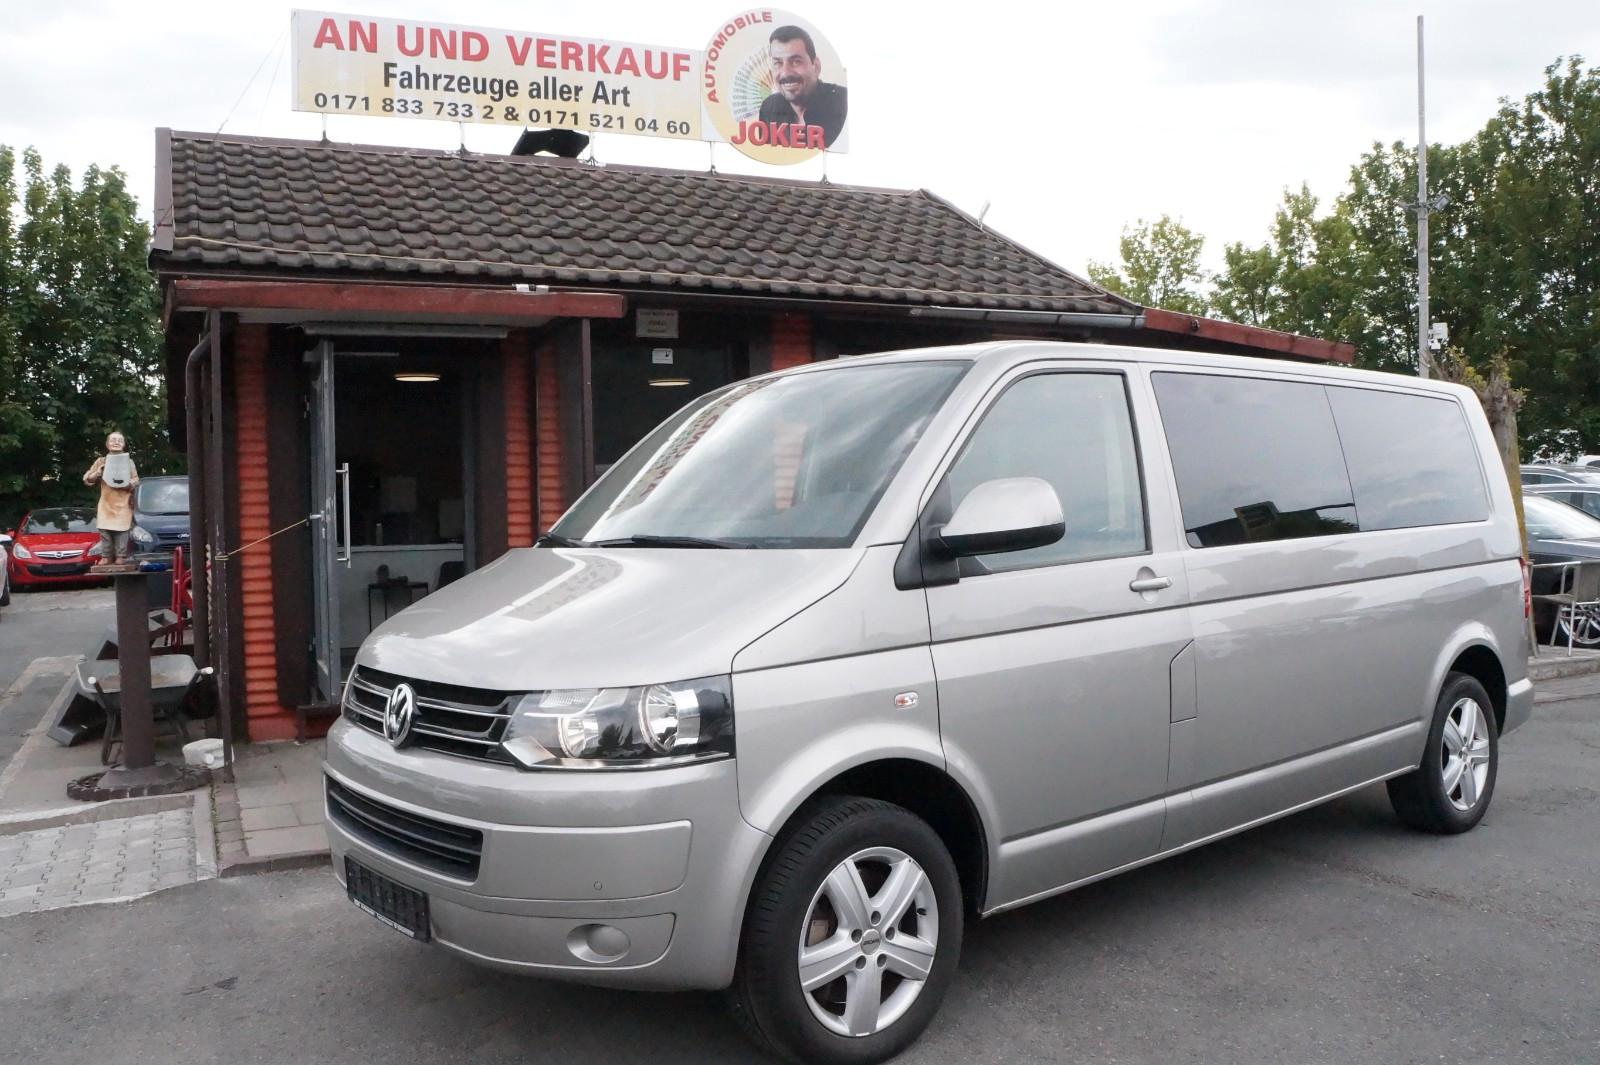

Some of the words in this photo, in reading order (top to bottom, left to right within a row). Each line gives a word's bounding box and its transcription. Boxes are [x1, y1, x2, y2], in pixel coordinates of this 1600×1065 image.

[313, 18, 377, 53] AN
[397, 24, 489, 62] UND
[505, 35, 690, 81] VERKAUF
[705, 11, 772, 103] AUTOMOBILE
[383, 62, 519, 102] Fahrzeuge
[528, 76, 583, 103] aller
[592, 80, 630, 107] Art
[314, 93, 370, 111] 0171
[382, 98, 423, 115] 833
[433, 102, 473, 118] 733
[482, 105, 494, 120] 2
[504, 106, 519, 122] &
[528, 108, 579, 126] 0171
[589, 114, 625, 130] 521
[635, 117, 659, 133] 04
[667, 120, 690, 136] 60
[731, 120, 826, 151] JOKER
